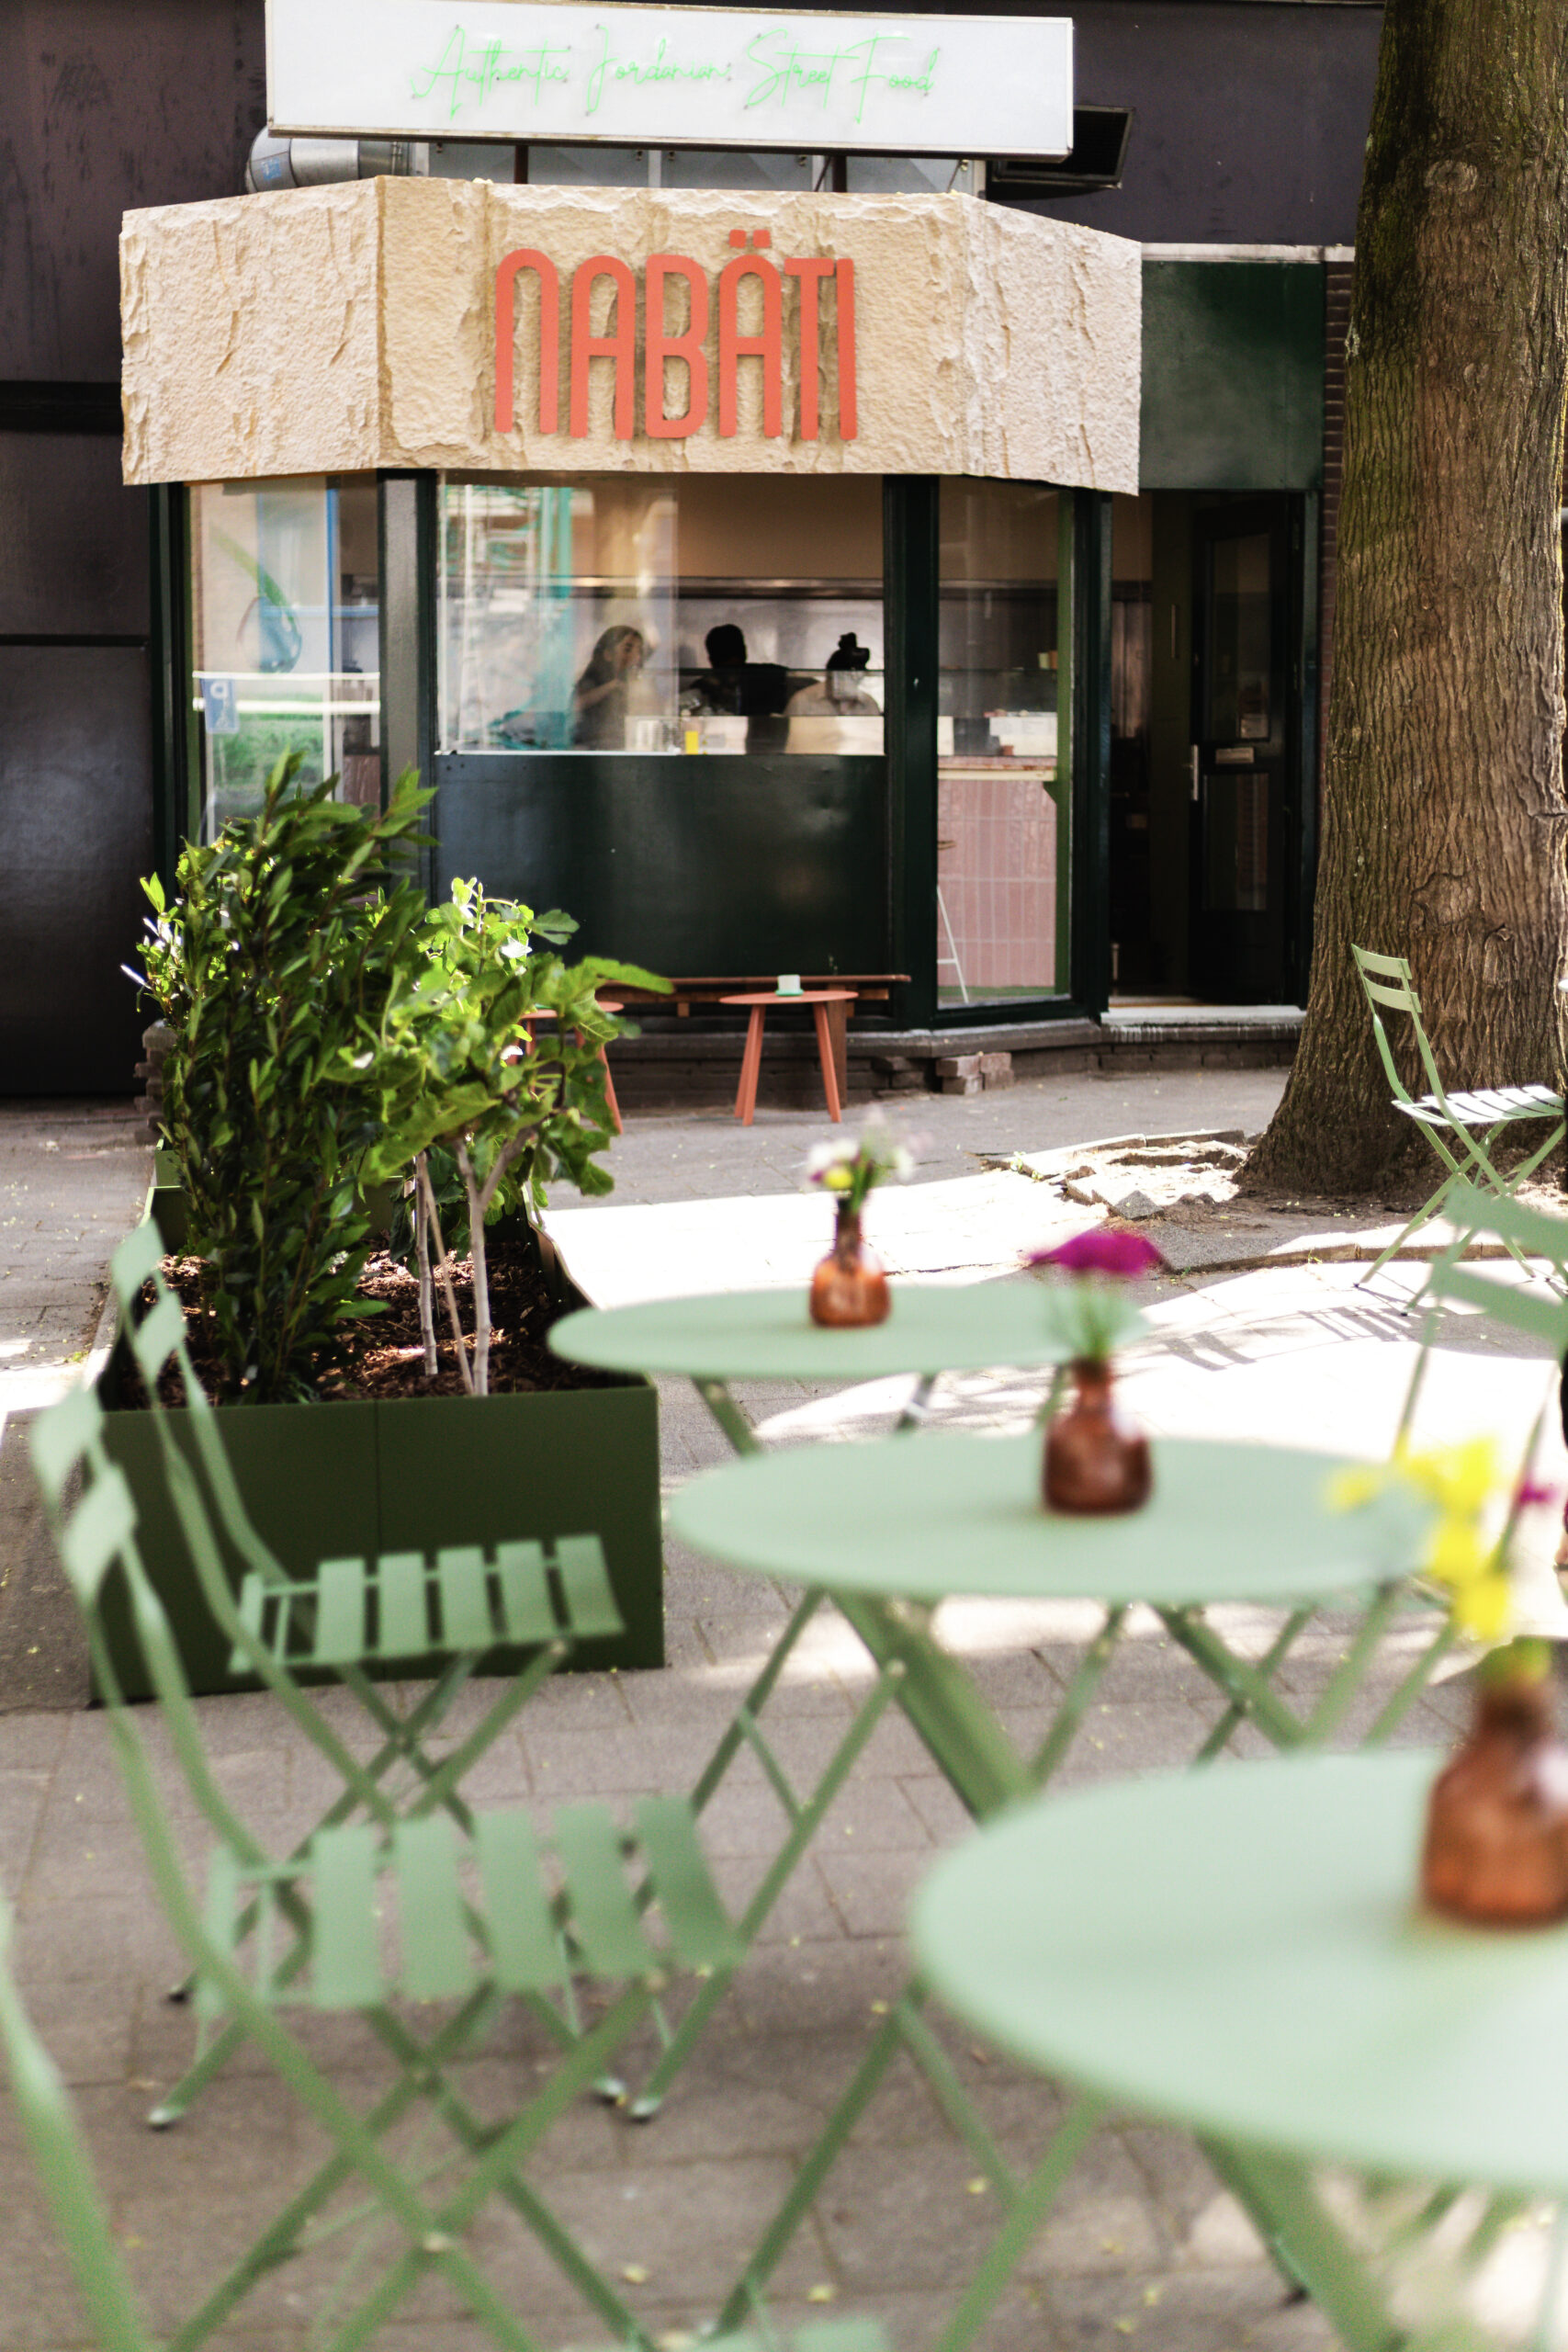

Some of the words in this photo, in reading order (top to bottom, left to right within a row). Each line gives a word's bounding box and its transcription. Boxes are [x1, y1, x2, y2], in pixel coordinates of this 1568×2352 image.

[410, 27, 570, 120] Authentic
[587, 26, 730, 112] Jordanian
[746, 28, 860, 108] Street
[845, 32, 939, 124] Food
